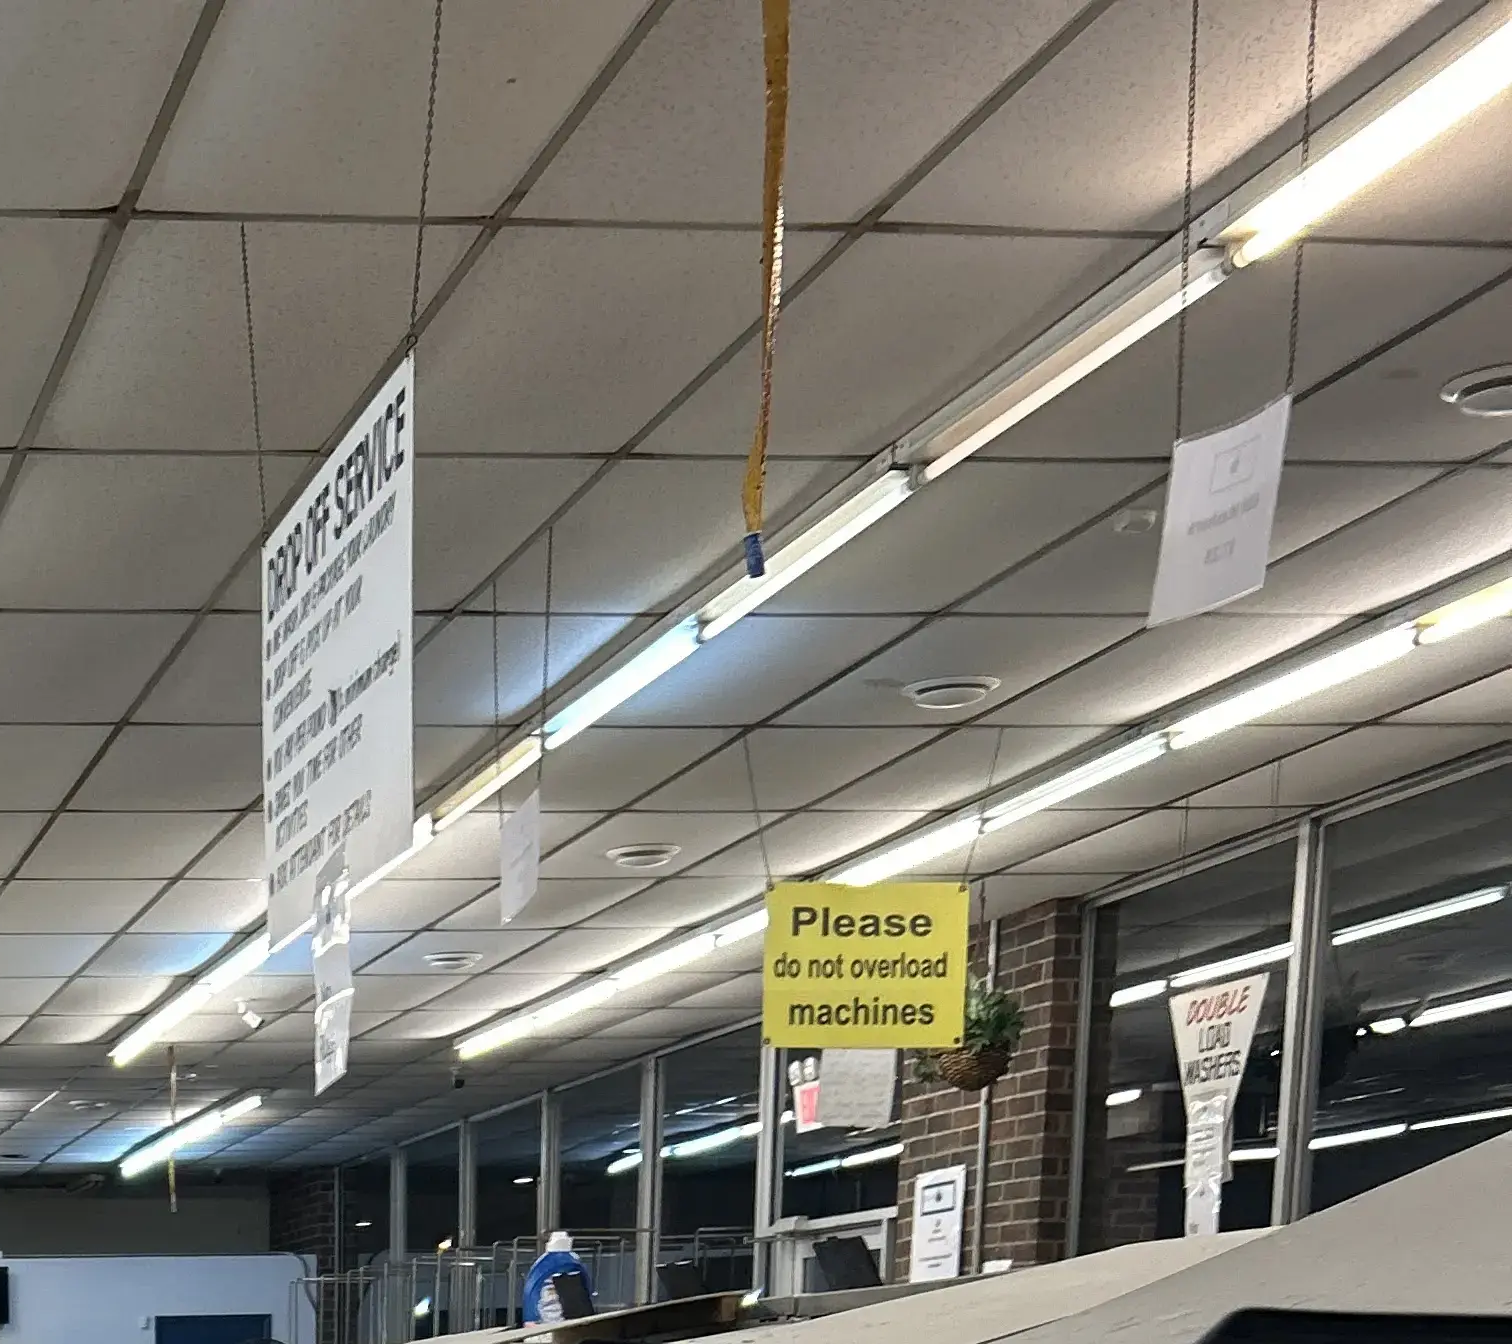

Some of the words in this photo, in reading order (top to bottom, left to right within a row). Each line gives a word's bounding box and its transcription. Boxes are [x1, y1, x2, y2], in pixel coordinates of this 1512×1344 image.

[267, 516, 302, 623] DROP
[305, 479, 330, 578] OFF
[333, 383, 405, 543] SERVICE
[792, 906, 933, 937] Please
[774, 952, 800, 978] do
[808, 954, 844, 979] not
[851, 952, 948, 979] overload
[789, 997, 934, 1025] machines
[1187, 985, 1251, 1026] DOUBLE
[1199, 1022, 1232, 1053] LOAD
[1184, 1050, 1241, 1086] WASHERS
